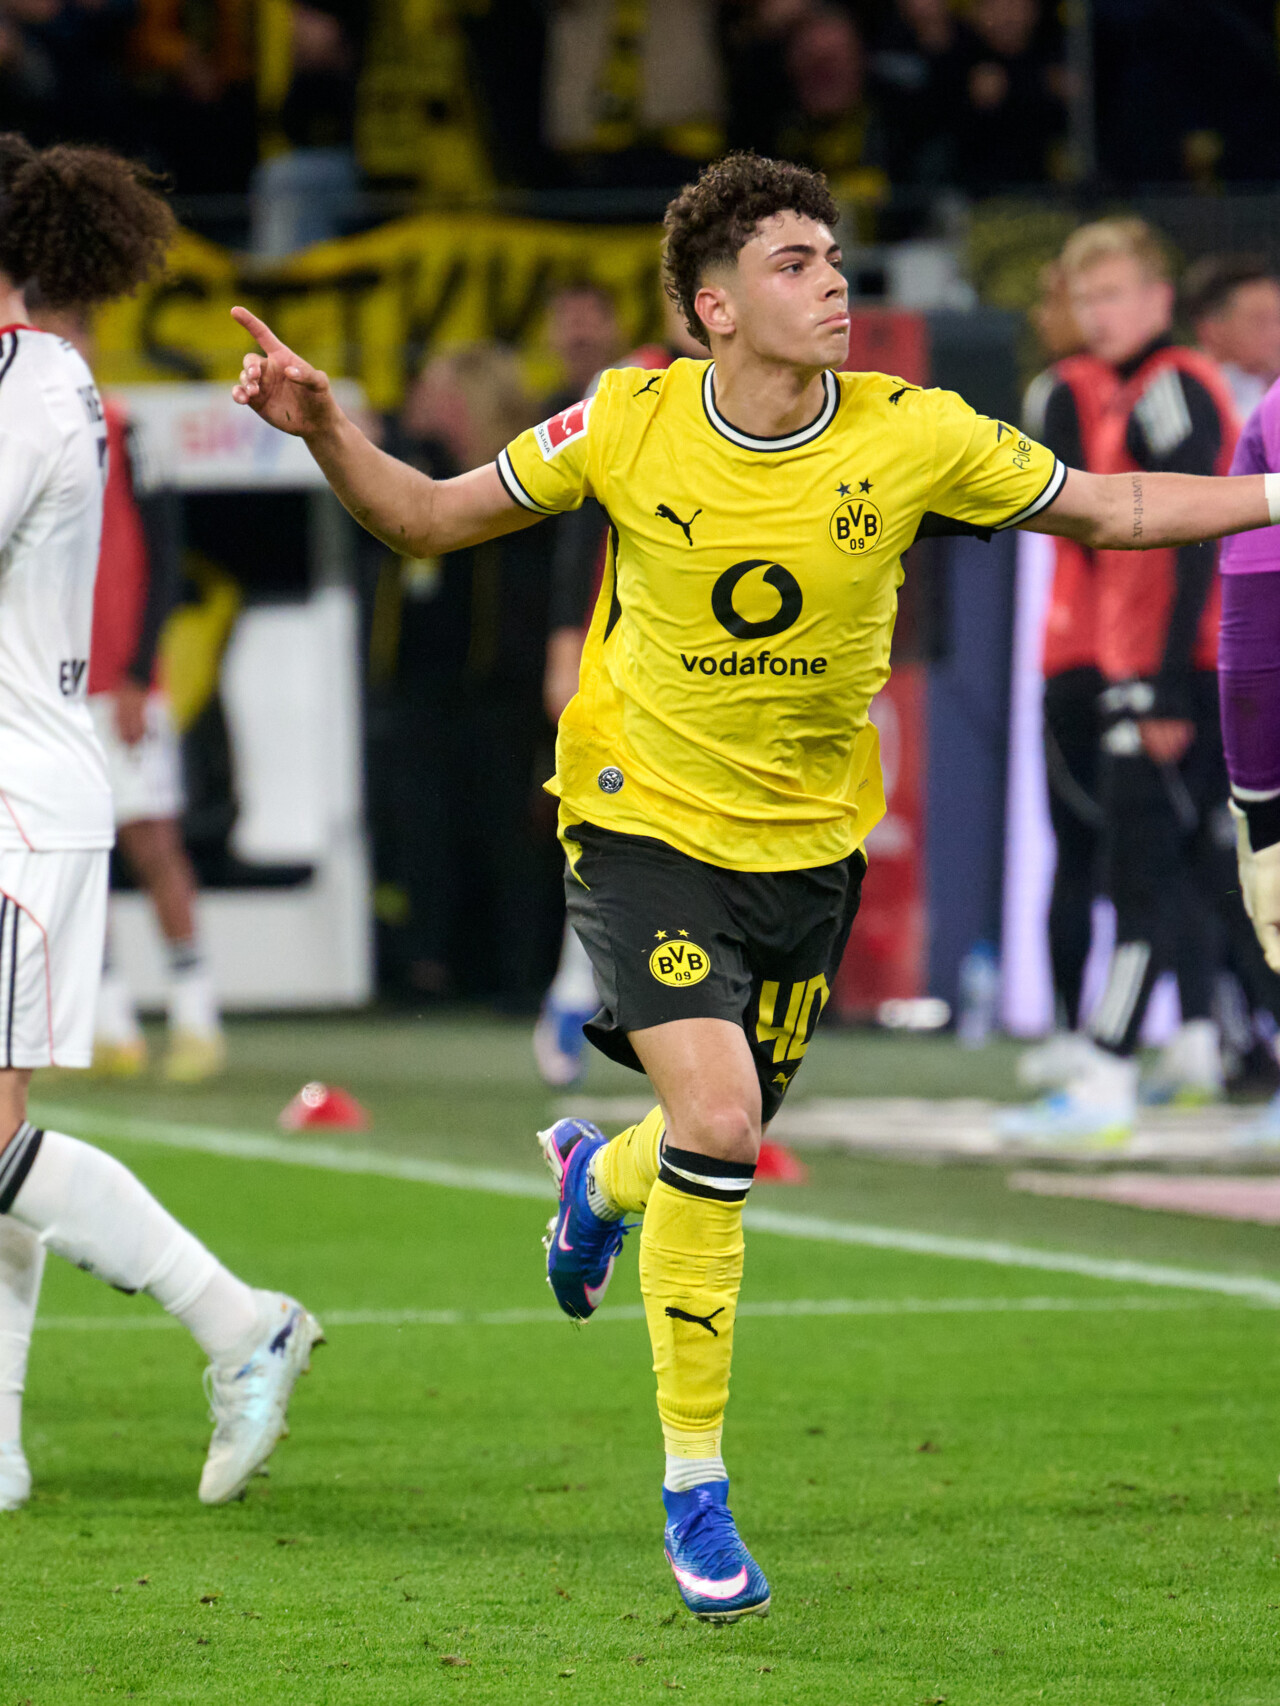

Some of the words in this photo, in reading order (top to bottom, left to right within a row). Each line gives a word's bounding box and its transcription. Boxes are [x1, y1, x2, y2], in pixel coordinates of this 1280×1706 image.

[836, 504, 878, 540] BVB
[849, 538, 865, 550] 09
[680, 651, 828, 676] vodafone
[658, 945, 703, 974] BVB
[675, 971, 691, 981] 09
[755, 972, 831, 1064] 40
